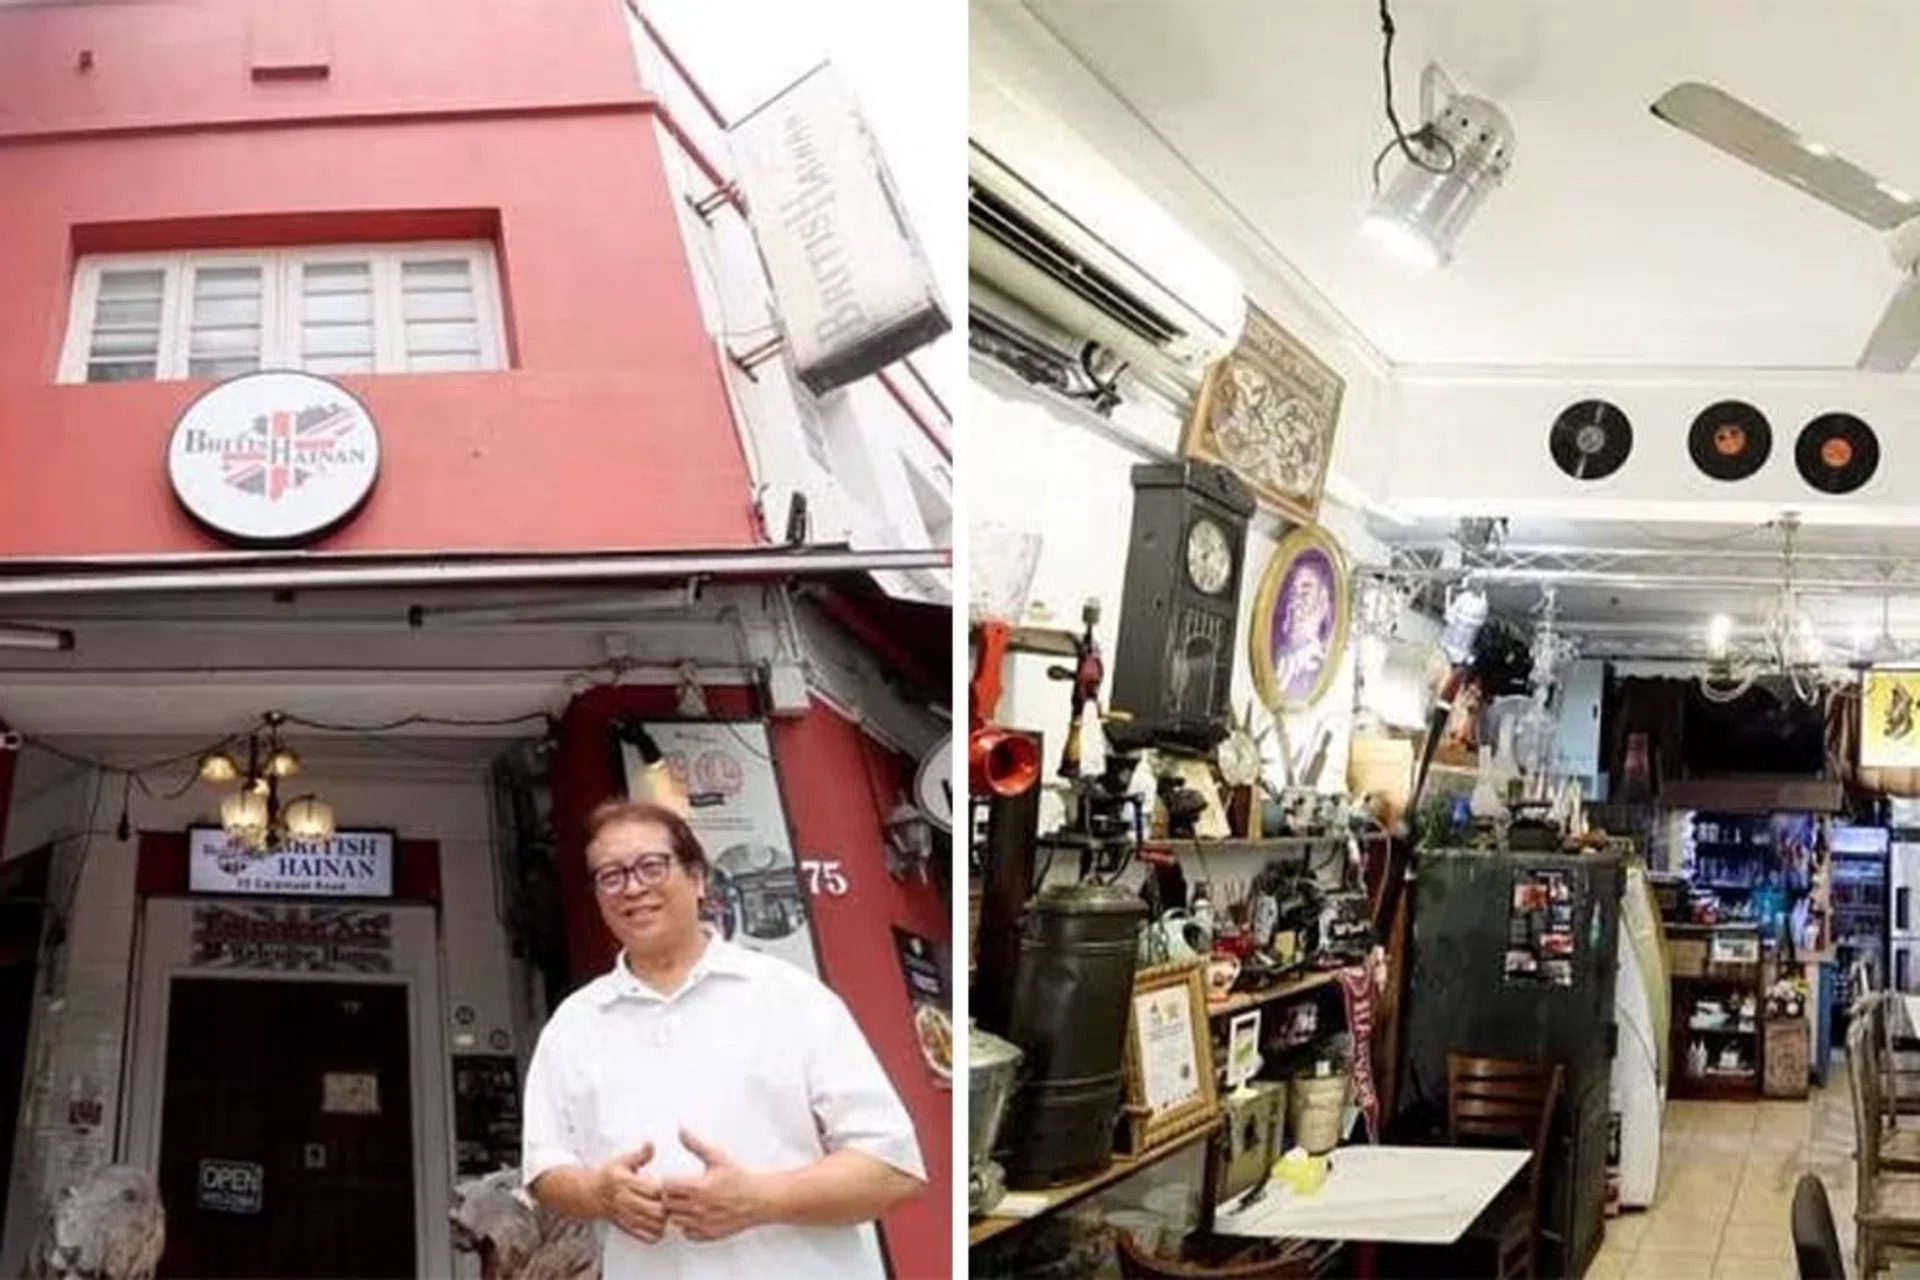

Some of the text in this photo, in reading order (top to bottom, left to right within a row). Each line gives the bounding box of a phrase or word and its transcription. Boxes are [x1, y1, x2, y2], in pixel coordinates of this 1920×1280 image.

[270, 438, 366, 465] HAINAN
[279, 857, 376, 879] HAINAN
[801, 859, 848, 896] 75
[203, 1165, 259, 1191] OPEN
